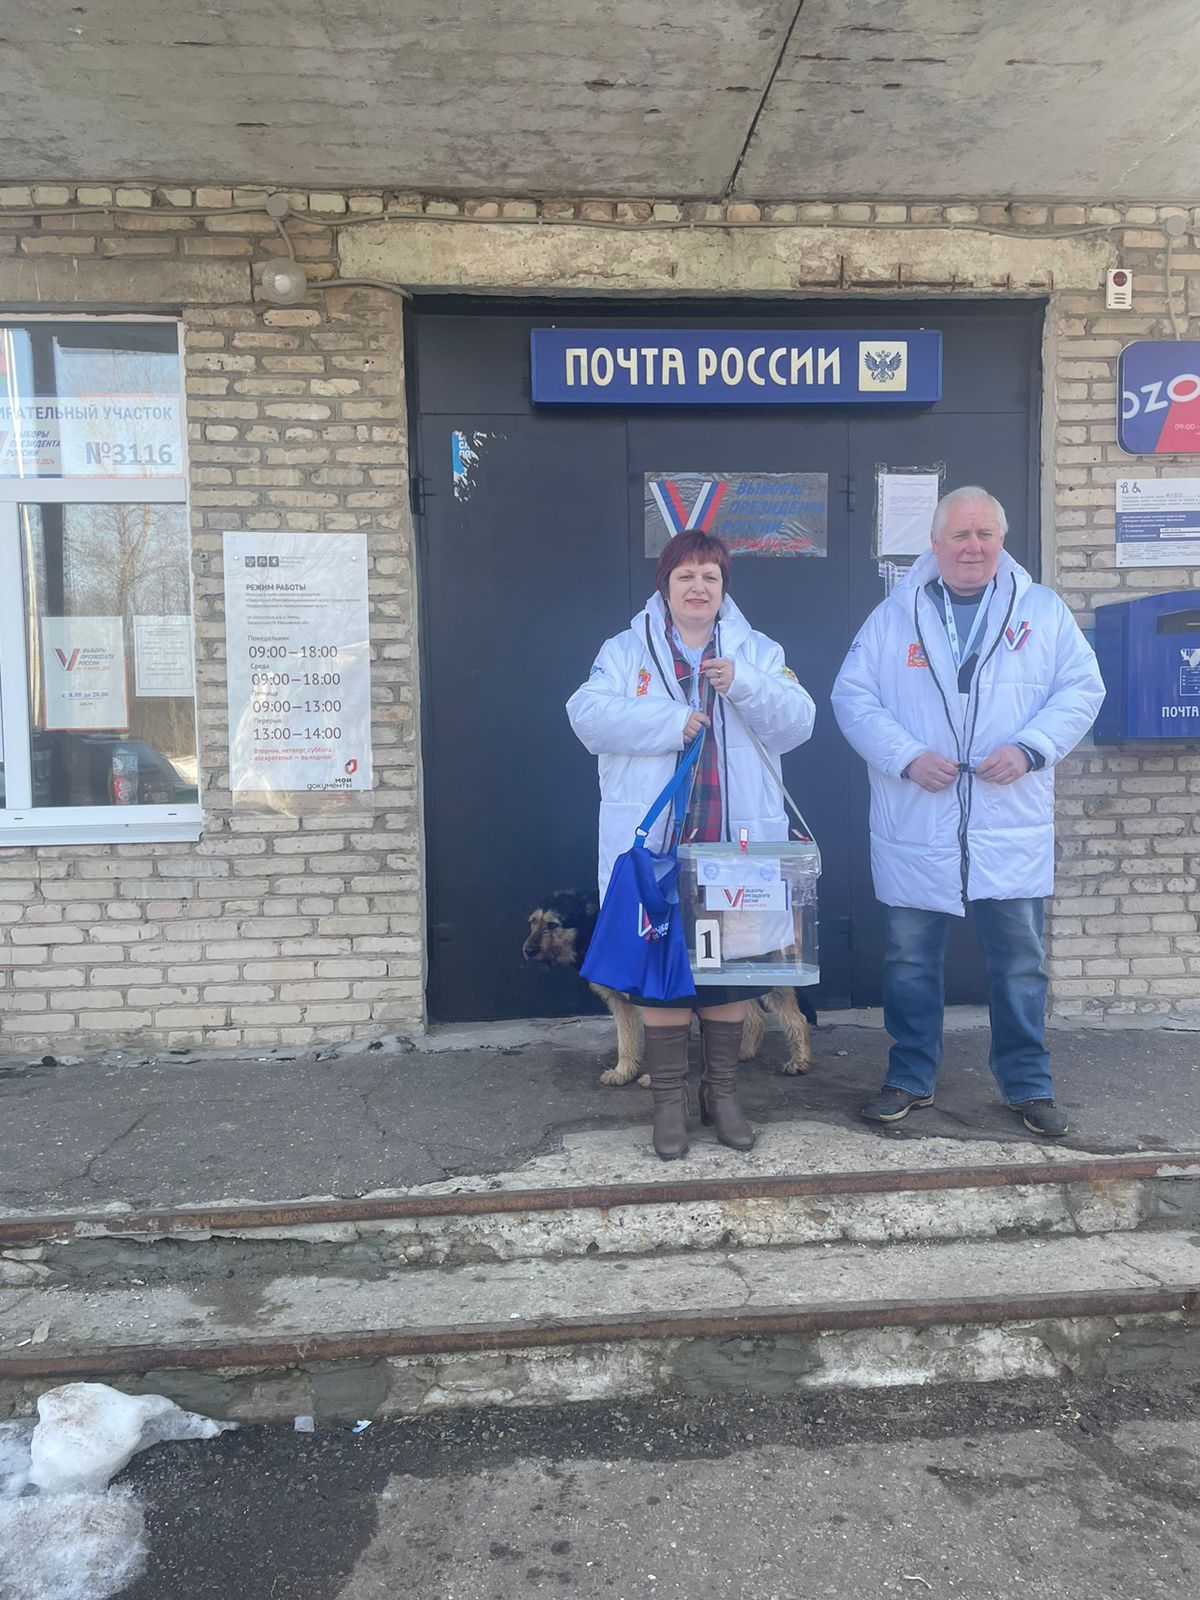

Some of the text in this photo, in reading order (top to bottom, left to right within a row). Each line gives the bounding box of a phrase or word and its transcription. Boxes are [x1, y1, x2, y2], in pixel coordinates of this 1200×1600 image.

[565, 346, 842, 386] ПОЧТА РОССИИ
[104, 406, 173, 420] УЧАСТОК
[9, 439, 61, 447] ПЕЗИДЕНТА
[245, 583, 306, 591] РЕЖИМ РАБОТЫ
[250, 663, 270, 671] Среда
[1161, 705, 1200, 718] ПОЧТА
[306, 782, 352, 790] документы
[700, 929, 714, 959] 1
